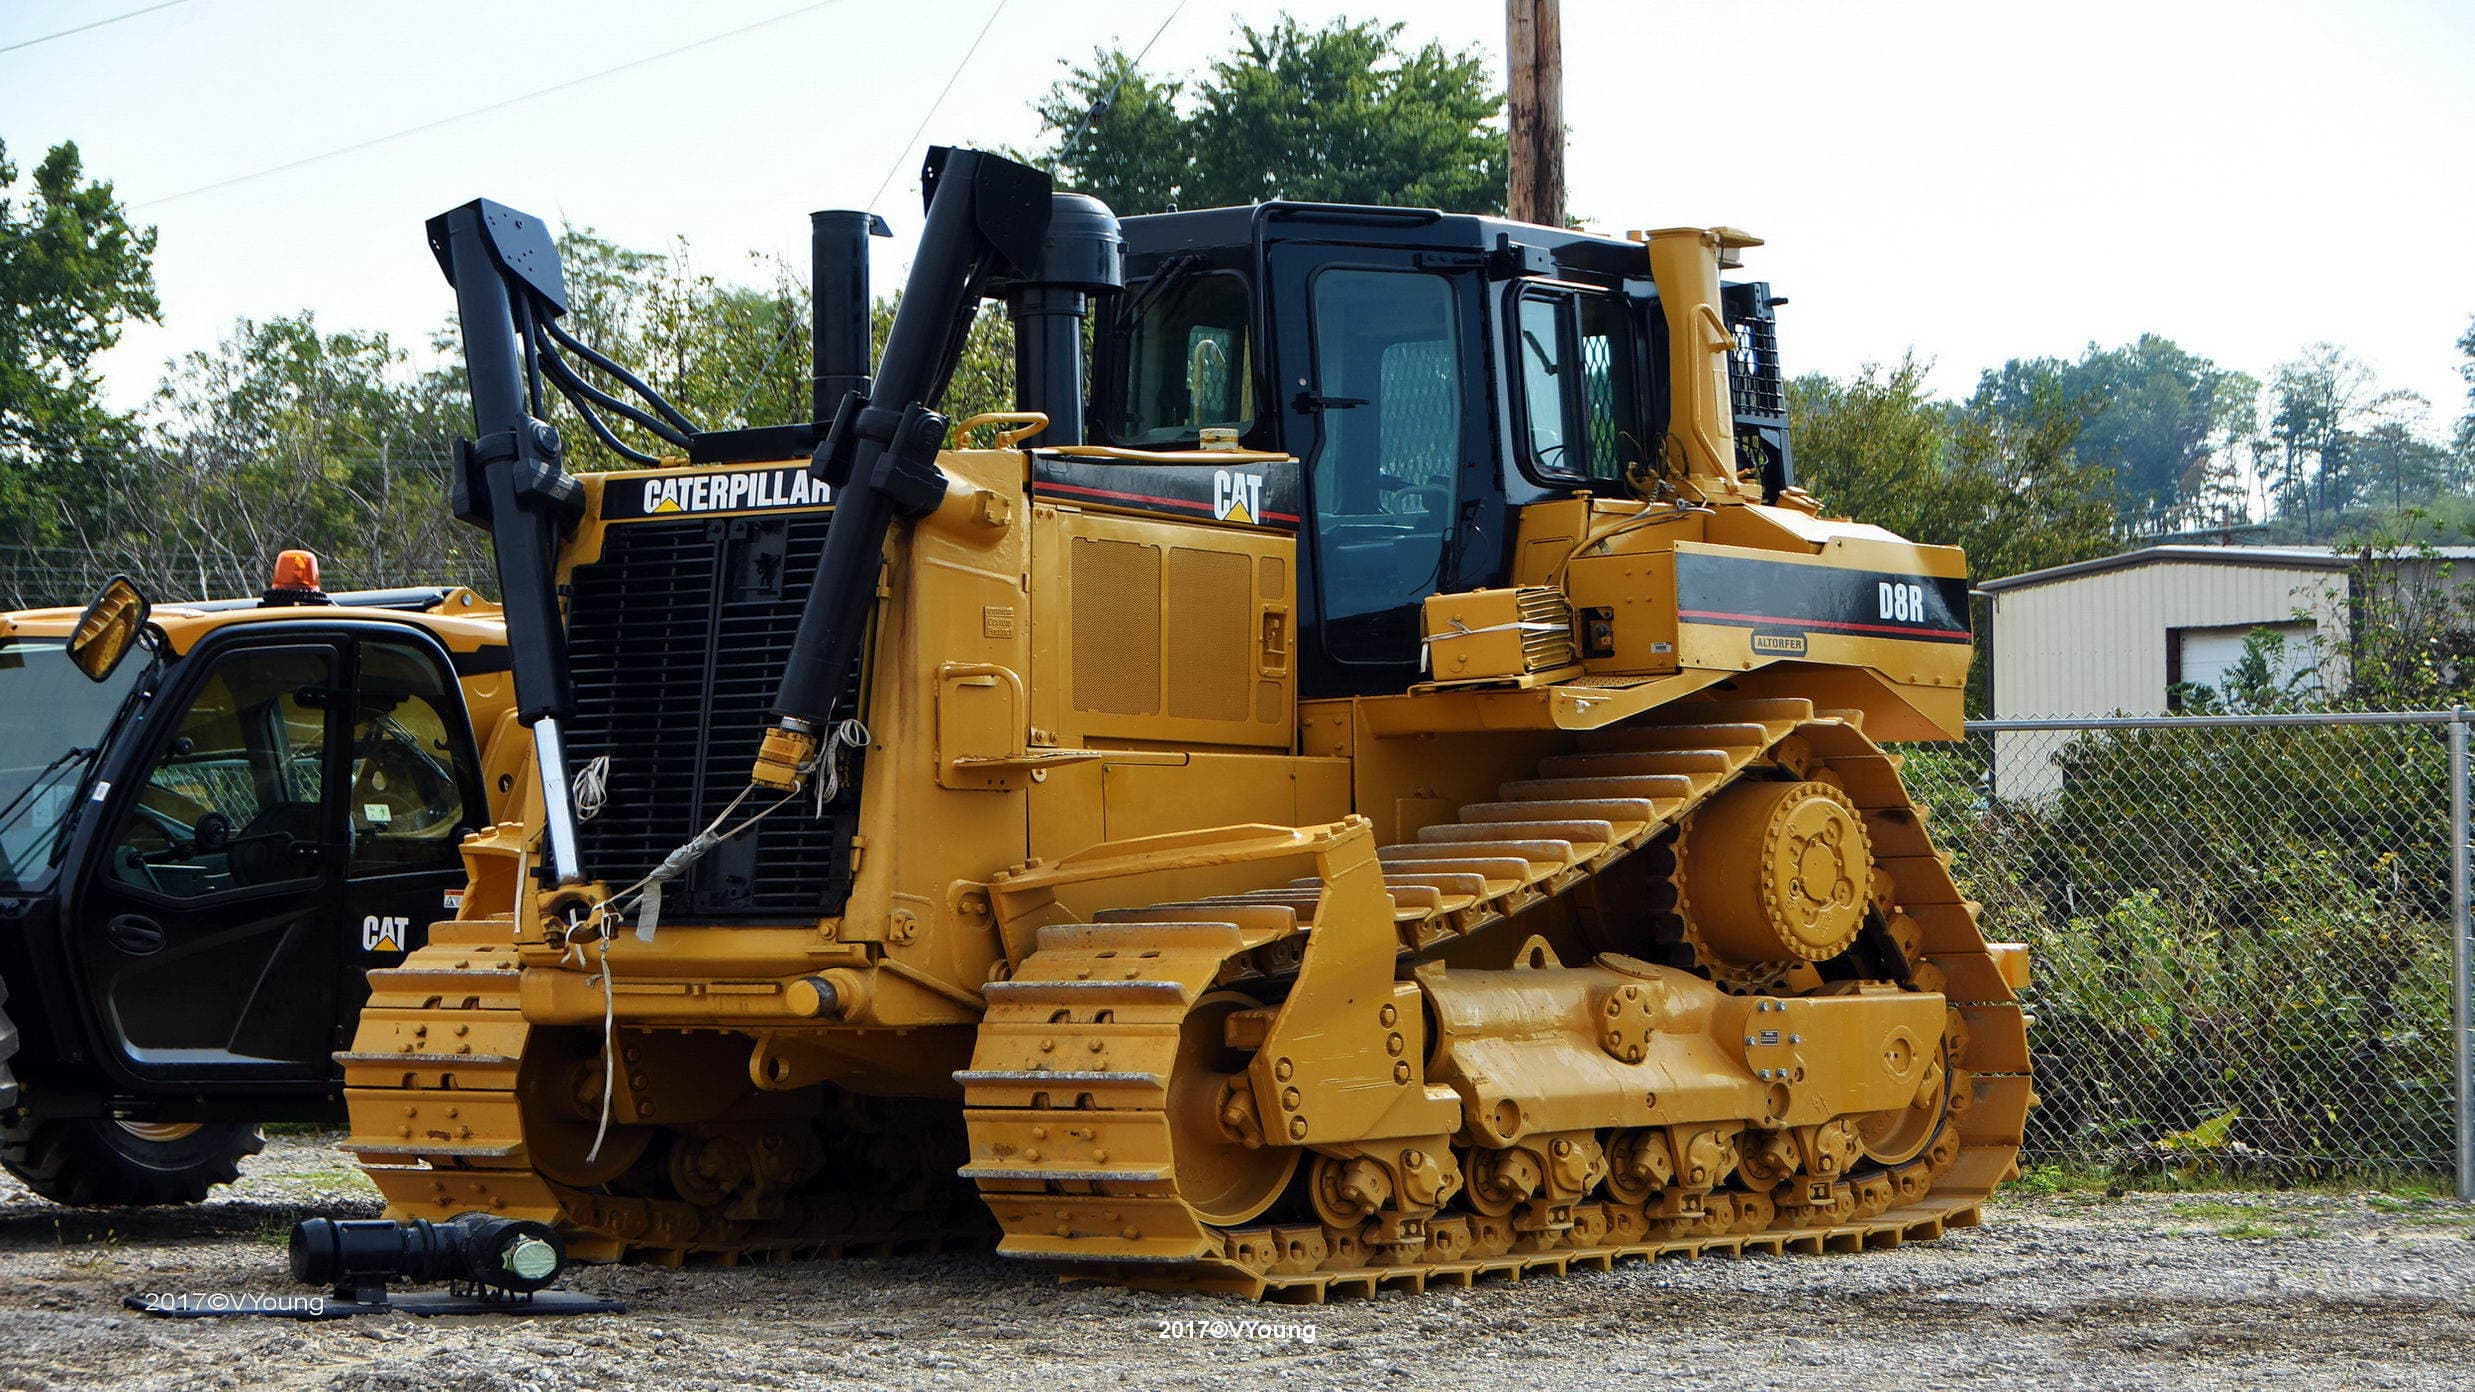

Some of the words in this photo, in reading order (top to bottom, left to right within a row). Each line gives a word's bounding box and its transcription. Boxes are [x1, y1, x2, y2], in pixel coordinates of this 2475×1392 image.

[1214, 469, 1263, 525] CAT
[1878, 581, 1924, 623] D8R
[1756, 637, 1802, 650] ALTORFER
[362, 915, 409, 952] CAT
